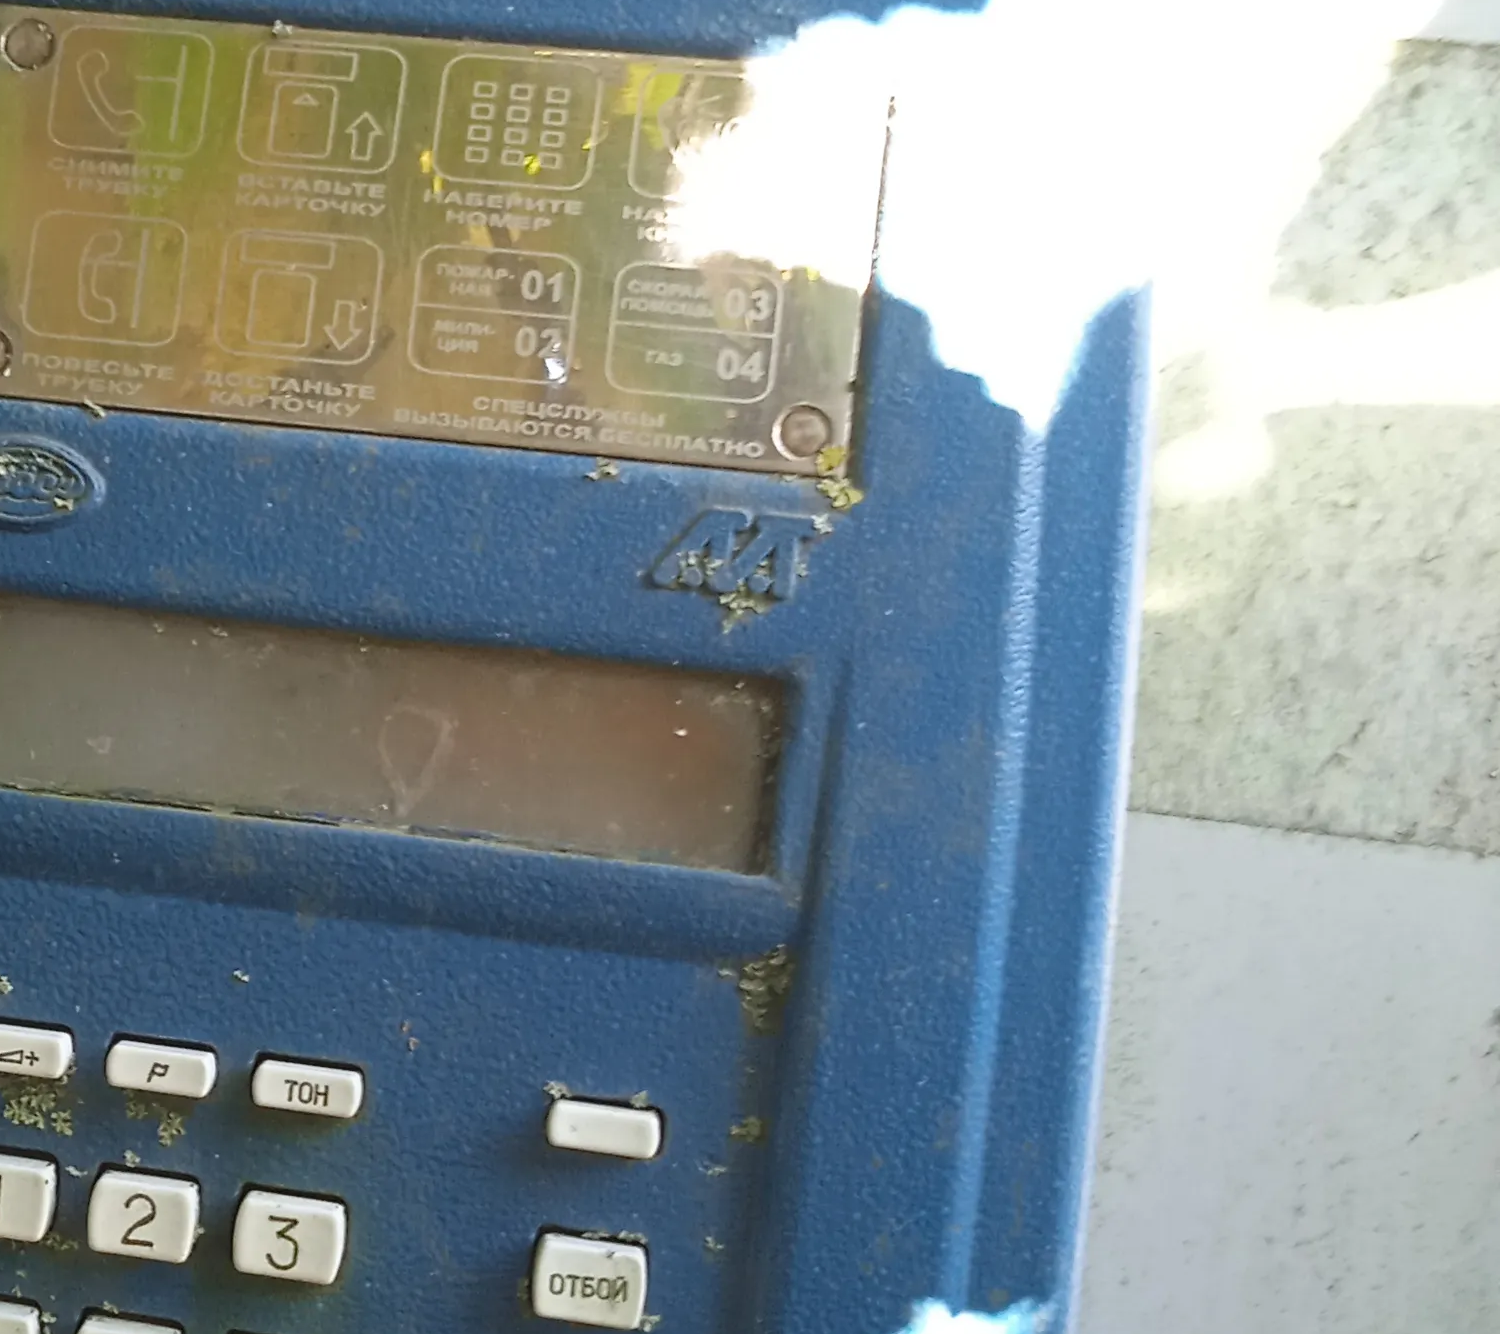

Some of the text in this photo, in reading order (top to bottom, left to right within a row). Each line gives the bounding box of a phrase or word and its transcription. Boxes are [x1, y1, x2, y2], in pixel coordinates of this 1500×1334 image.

[48, 157, 184, 181] СНИМИТЕ
[62, 176, 169, 199] ТРУБКУ
[237, 174, 387, 198] ВСТАВЬТЕ
[235, 192, 387, 217] КАРТОЧКУ
[424, 189, 584, 216] НАБЕРИТЕ
[445, 210, 552, 232] НОМЕР
[520, 270, 565, 303] 01
[725, 288, 772, 322] 03
[514, 326, 563, 359] 02
[22, 352, 174, 381] ПОВЕСЬТЕ
[645, 350, 684, 367] ГАЗ
[716, 349, 765, 383] 04
[38, 373, 144, 396] ТРУБКУ
[204, 372, 376, 401] ДОСТАНЬТЕ
[209, 391, 362, 417] КАРТОЧКУ
[473, 396, 667, 429] СПЕЦСЛУЖБЫ
[393, 408, 766, 459] ВЫЗЫВАЮТСЯ БЕСПЛАТНО
[284, 1079, 329, 1108] ТОН
[120, 1193, 157, 1248] 2
[266, 1215, 300, 1271] 3
[549, 1272, 628, 1303] ОТБОЙ
